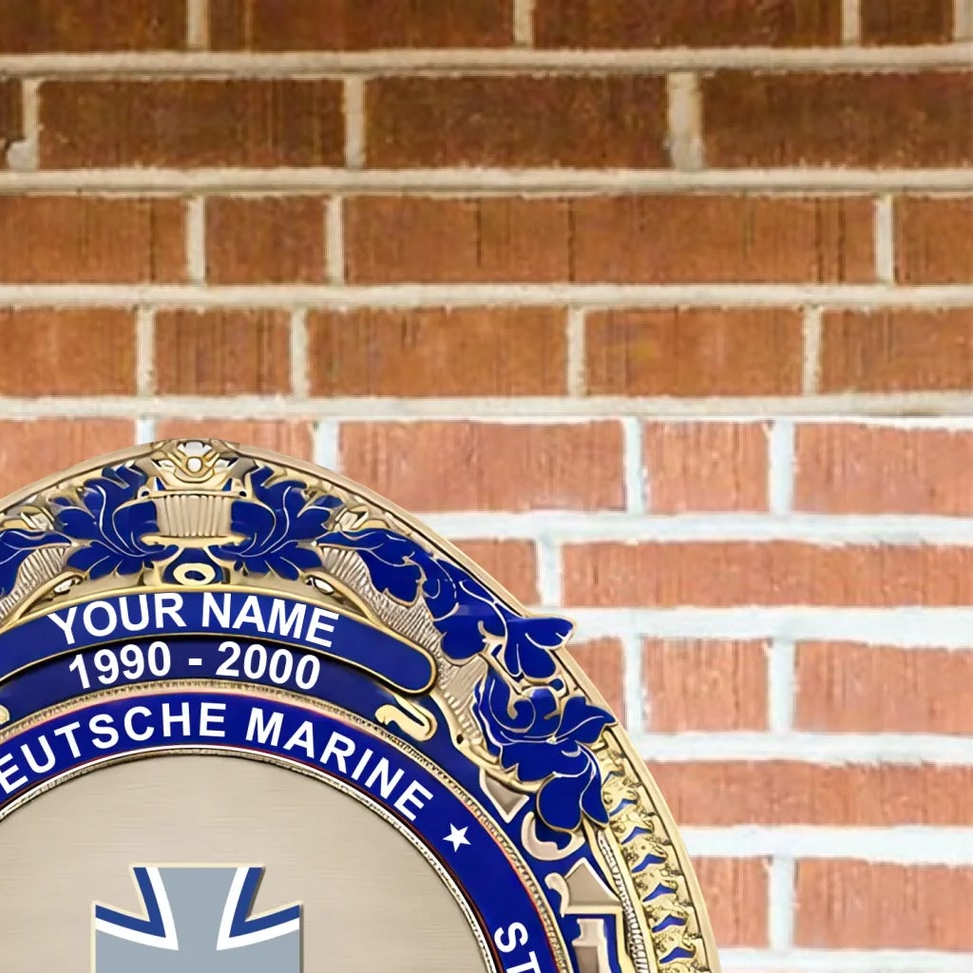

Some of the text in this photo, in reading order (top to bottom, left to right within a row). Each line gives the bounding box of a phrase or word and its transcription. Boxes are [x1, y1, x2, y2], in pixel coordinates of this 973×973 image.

[47, 592, 340, 648] YOUR NAME
[68, 640, 321, 691] 1990 - 2000
[245, 710, 434, 822] MARINE
